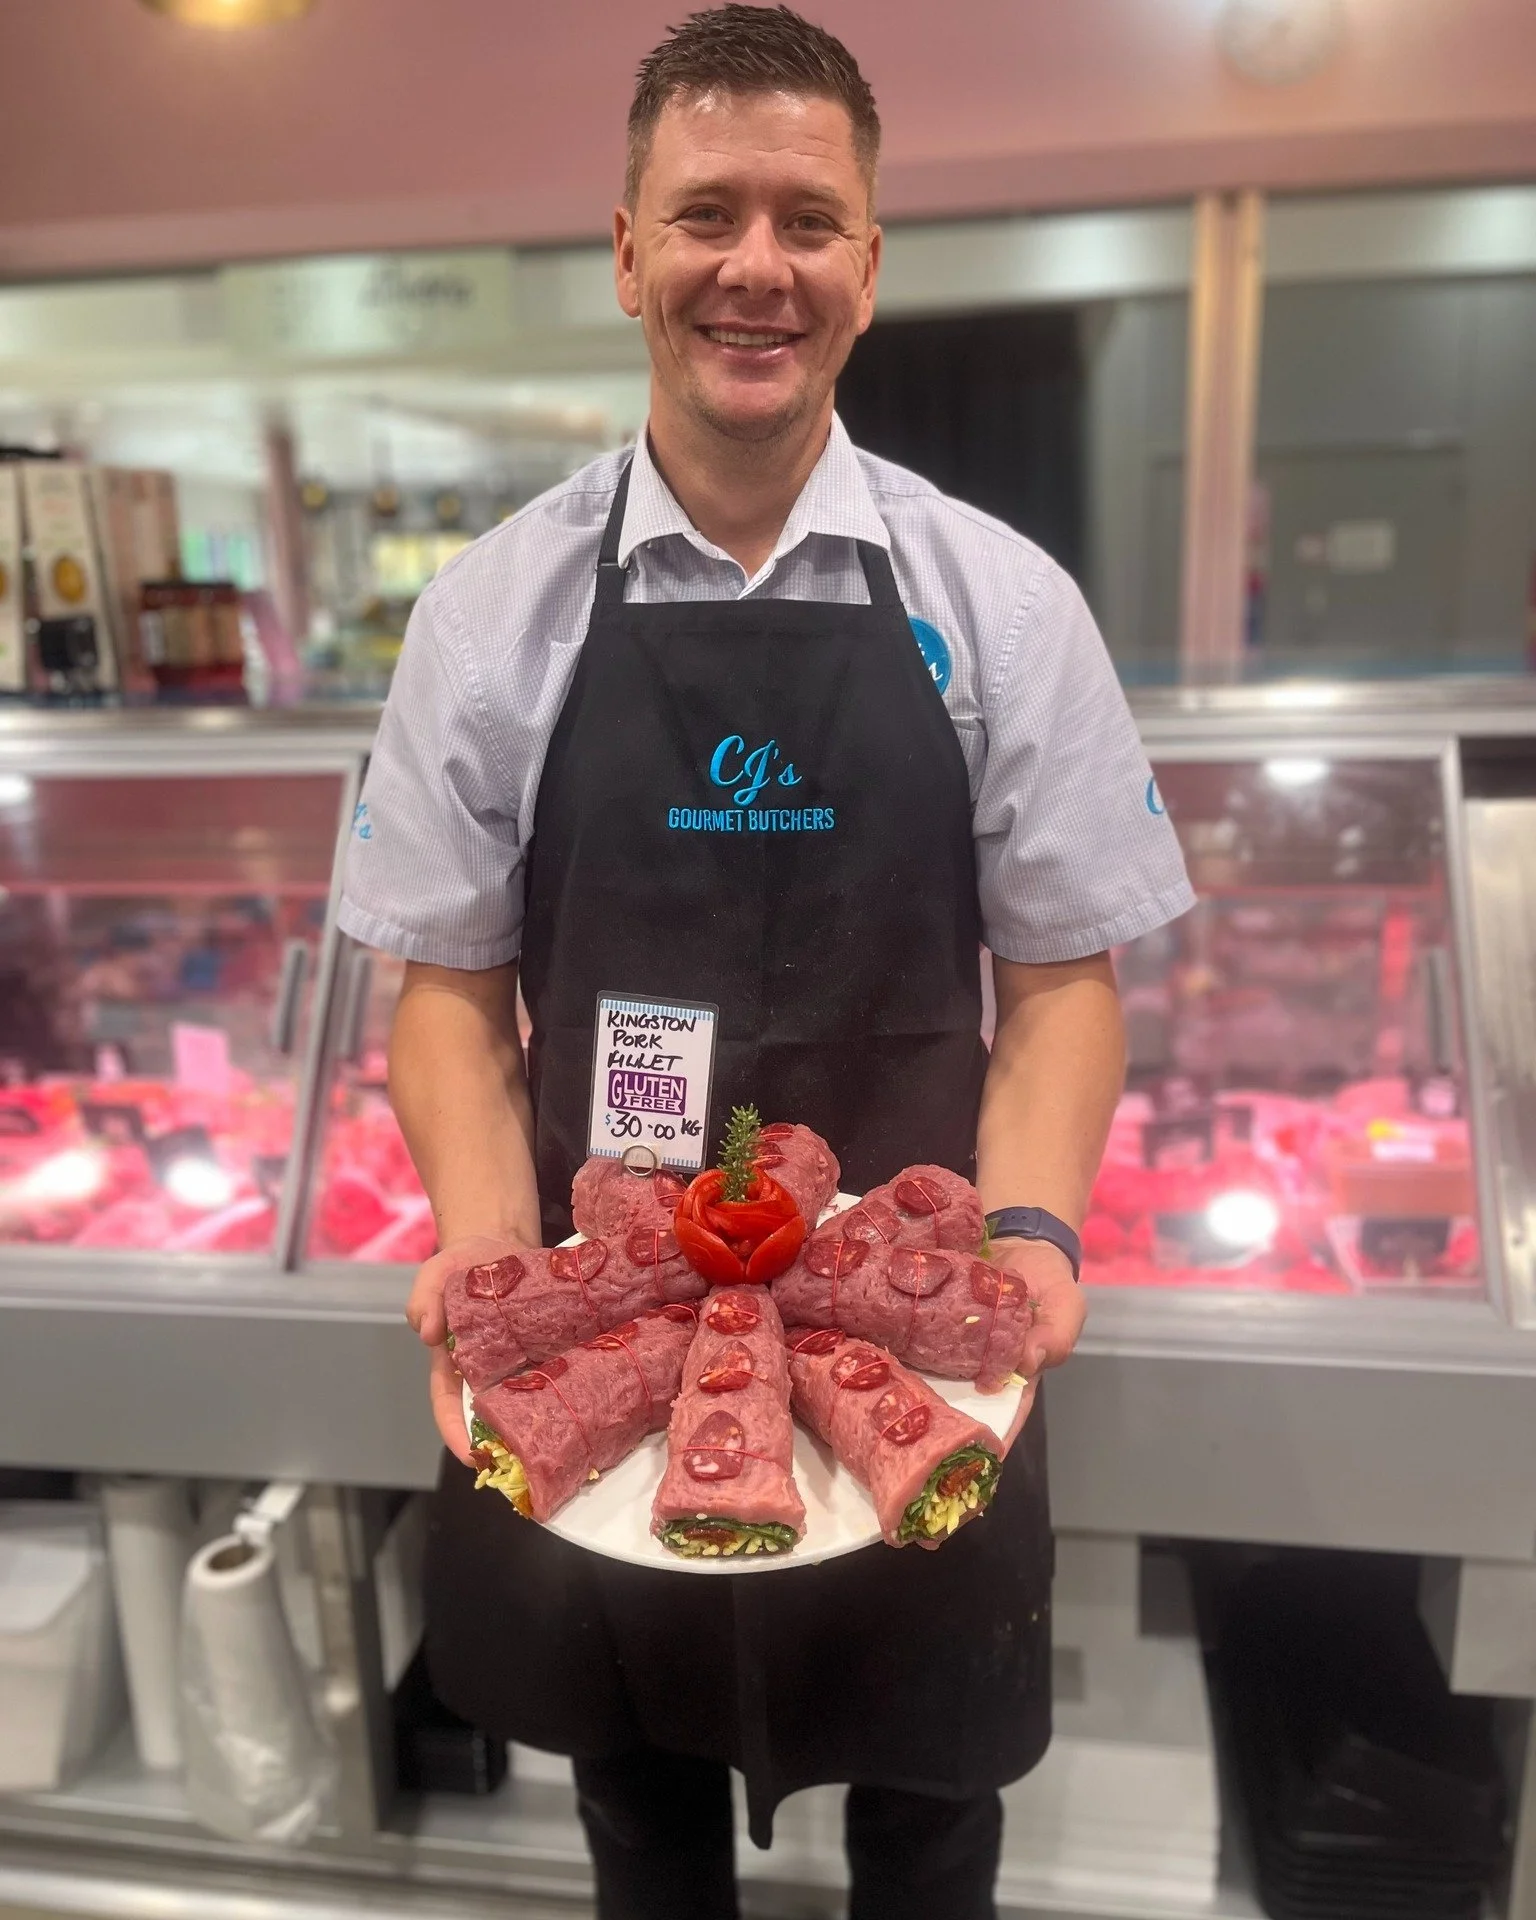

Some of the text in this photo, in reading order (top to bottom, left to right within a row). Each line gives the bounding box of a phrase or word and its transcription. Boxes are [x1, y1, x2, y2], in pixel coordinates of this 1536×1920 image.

[709, 735, 802, 807] CJ's
[668, 807, 835, 832] GOURMET BUTCHERS
[607, 1010, 697, 1033] KINGSTON
[612, 1030, 663, 1049] PORK
[607, 1050, 683, 1071] FILLET
[611, 1073, 684, 1106] GLUTEN
[629, 1097, 676, 1111] FREE
[681, 1118, 703, 1137] KG
